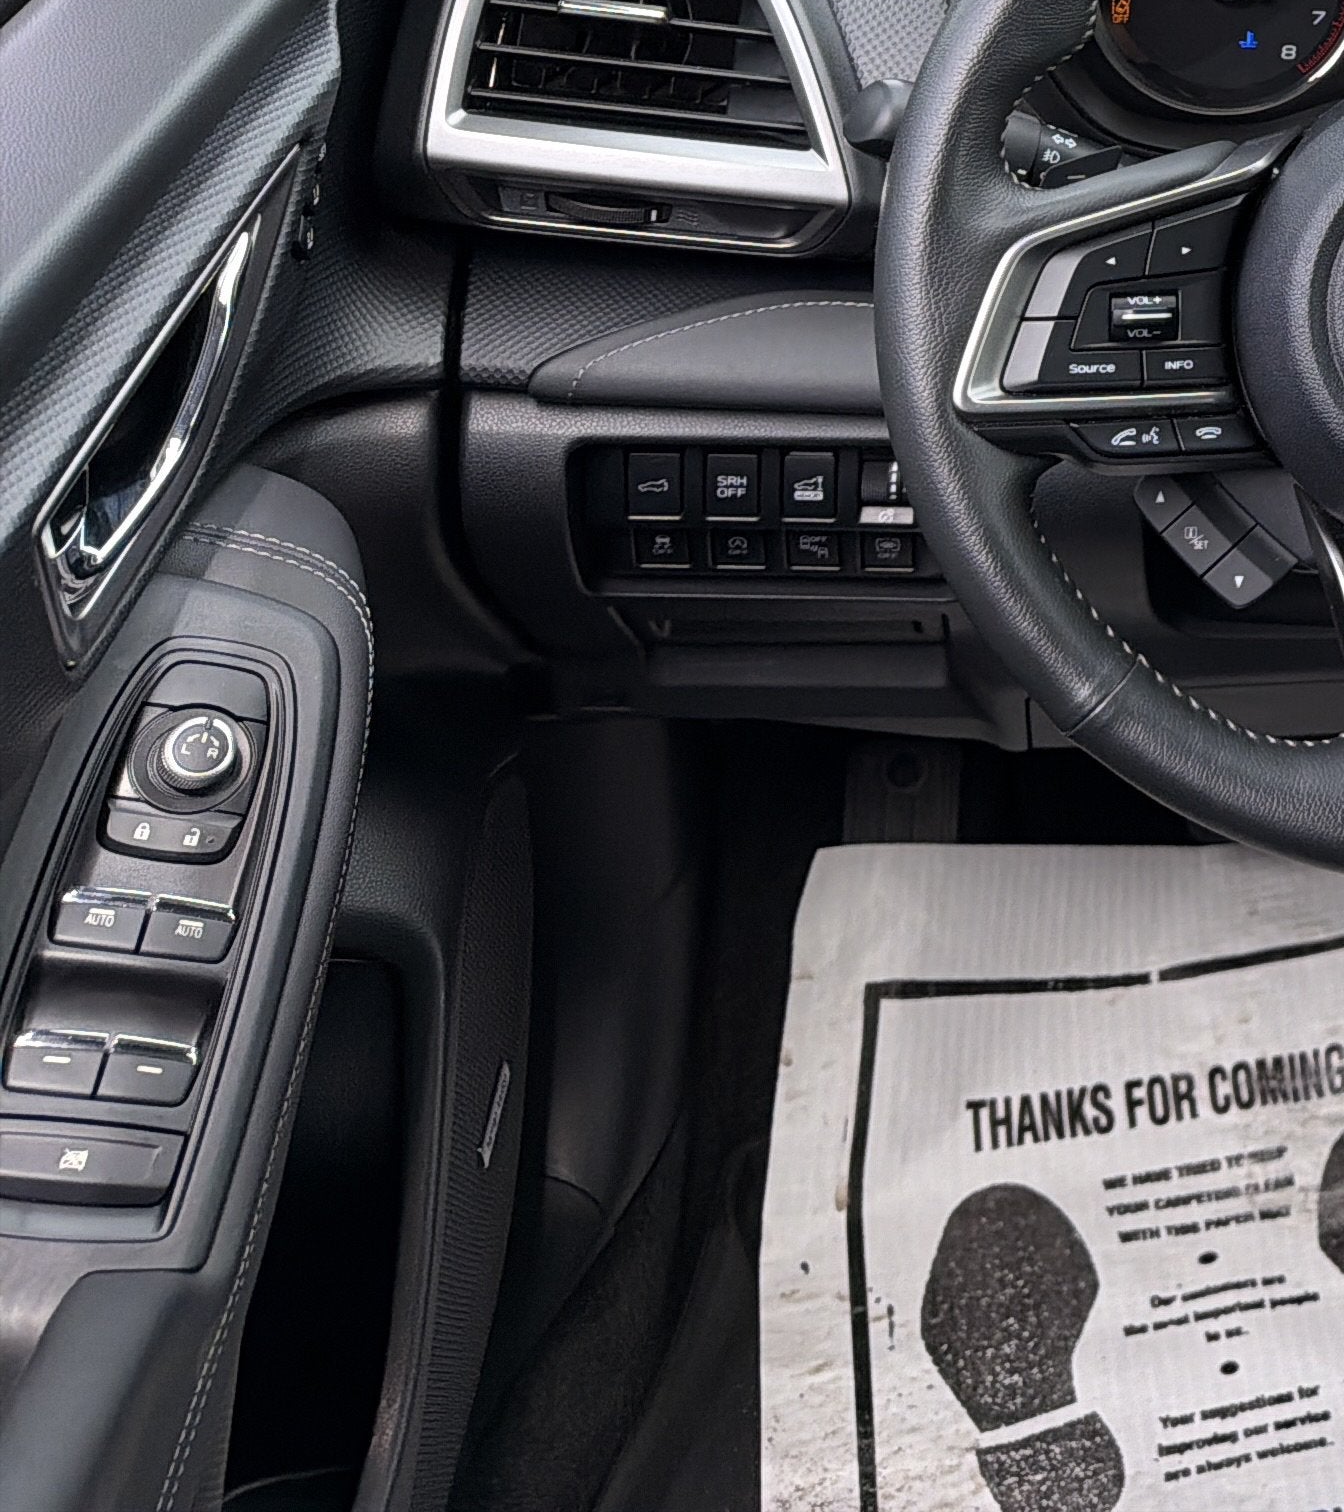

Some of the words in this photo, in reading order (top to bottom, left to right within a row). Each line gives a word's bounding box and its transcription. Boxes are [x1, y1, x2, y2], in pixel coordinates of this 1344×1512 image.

[1311, 11, 1326, 25] 7
[1281, 45, 1296, 60] 8
[1126, 295, 1163, 306] VOL+
[1069, 362, 1116, 375] Source
[1164, 359, 1194, 370] INFO
[716, 475, 747, 487] SRH
[716, 487, 747, 499] OFF
[181, 743, 191, 755] L
[207, 748, 219, 760] R
[84, 914, 115, 928] AUTO
[175, 925, 204, 938] AUTO
[965, 1082, 1116, 1153] THANKS
[1123, 1071, 1200, 1129] FOR
